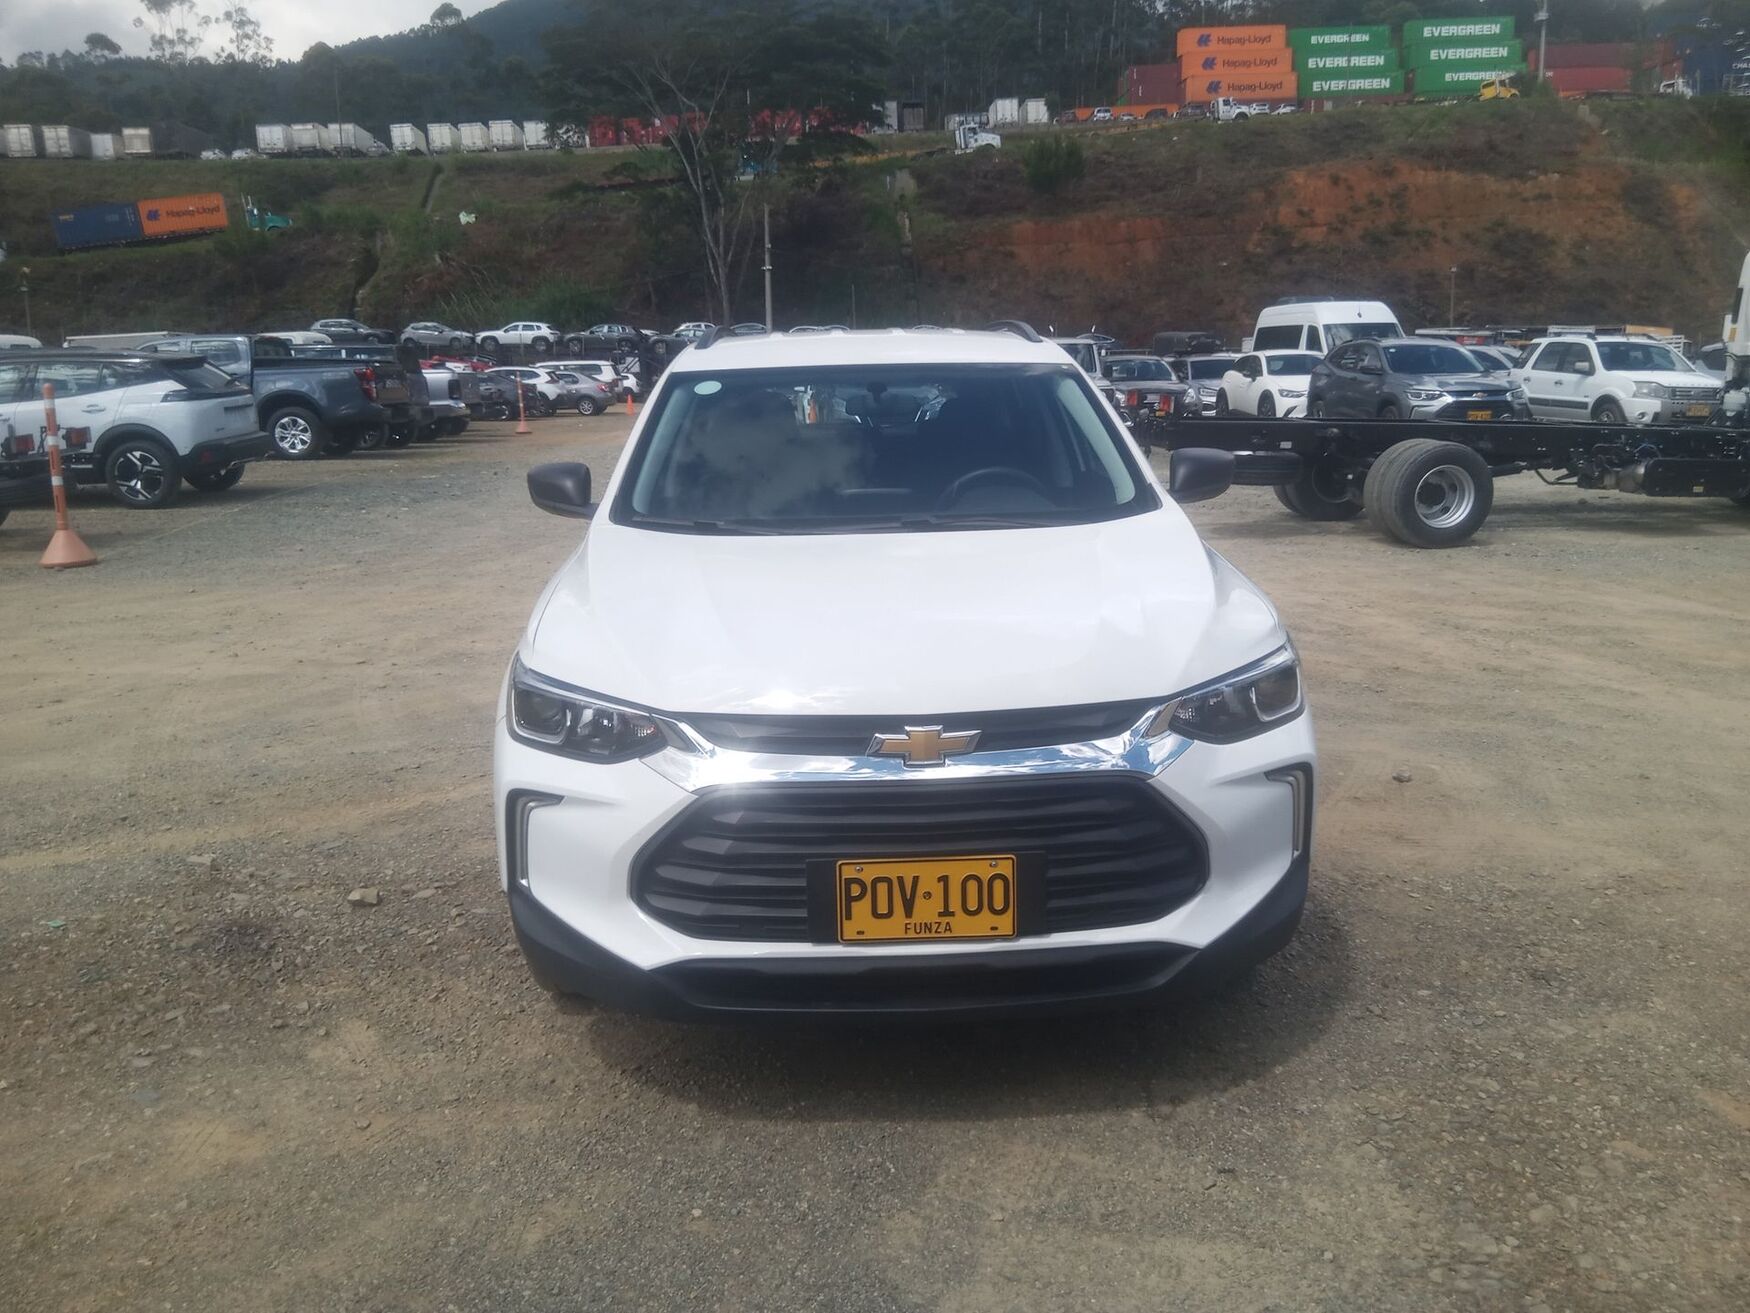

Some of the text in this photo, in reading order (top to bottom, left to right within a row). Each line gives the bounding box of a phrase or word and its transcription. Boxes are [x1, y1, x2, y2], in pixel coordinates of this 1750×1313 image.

[1424, 23, 1501, 37] EVERGREEN
[1217, 34, 1272, 46] Hapag-Lloyd
[1311, 33, 1370, 44] EVERGREEN
[1430, 47, 1508, 61] EVERGREEN
[1222, 57, 1278, 68] Hapag-Lloyd
[1309, 55, 1385, 69] EVERGREEN
[1227, 80, 1283, 92] Hapag-Lloyd
[1312, 78, 1391, 92] EVERGREEN
[904, 921, 953, 935] FUNZA
